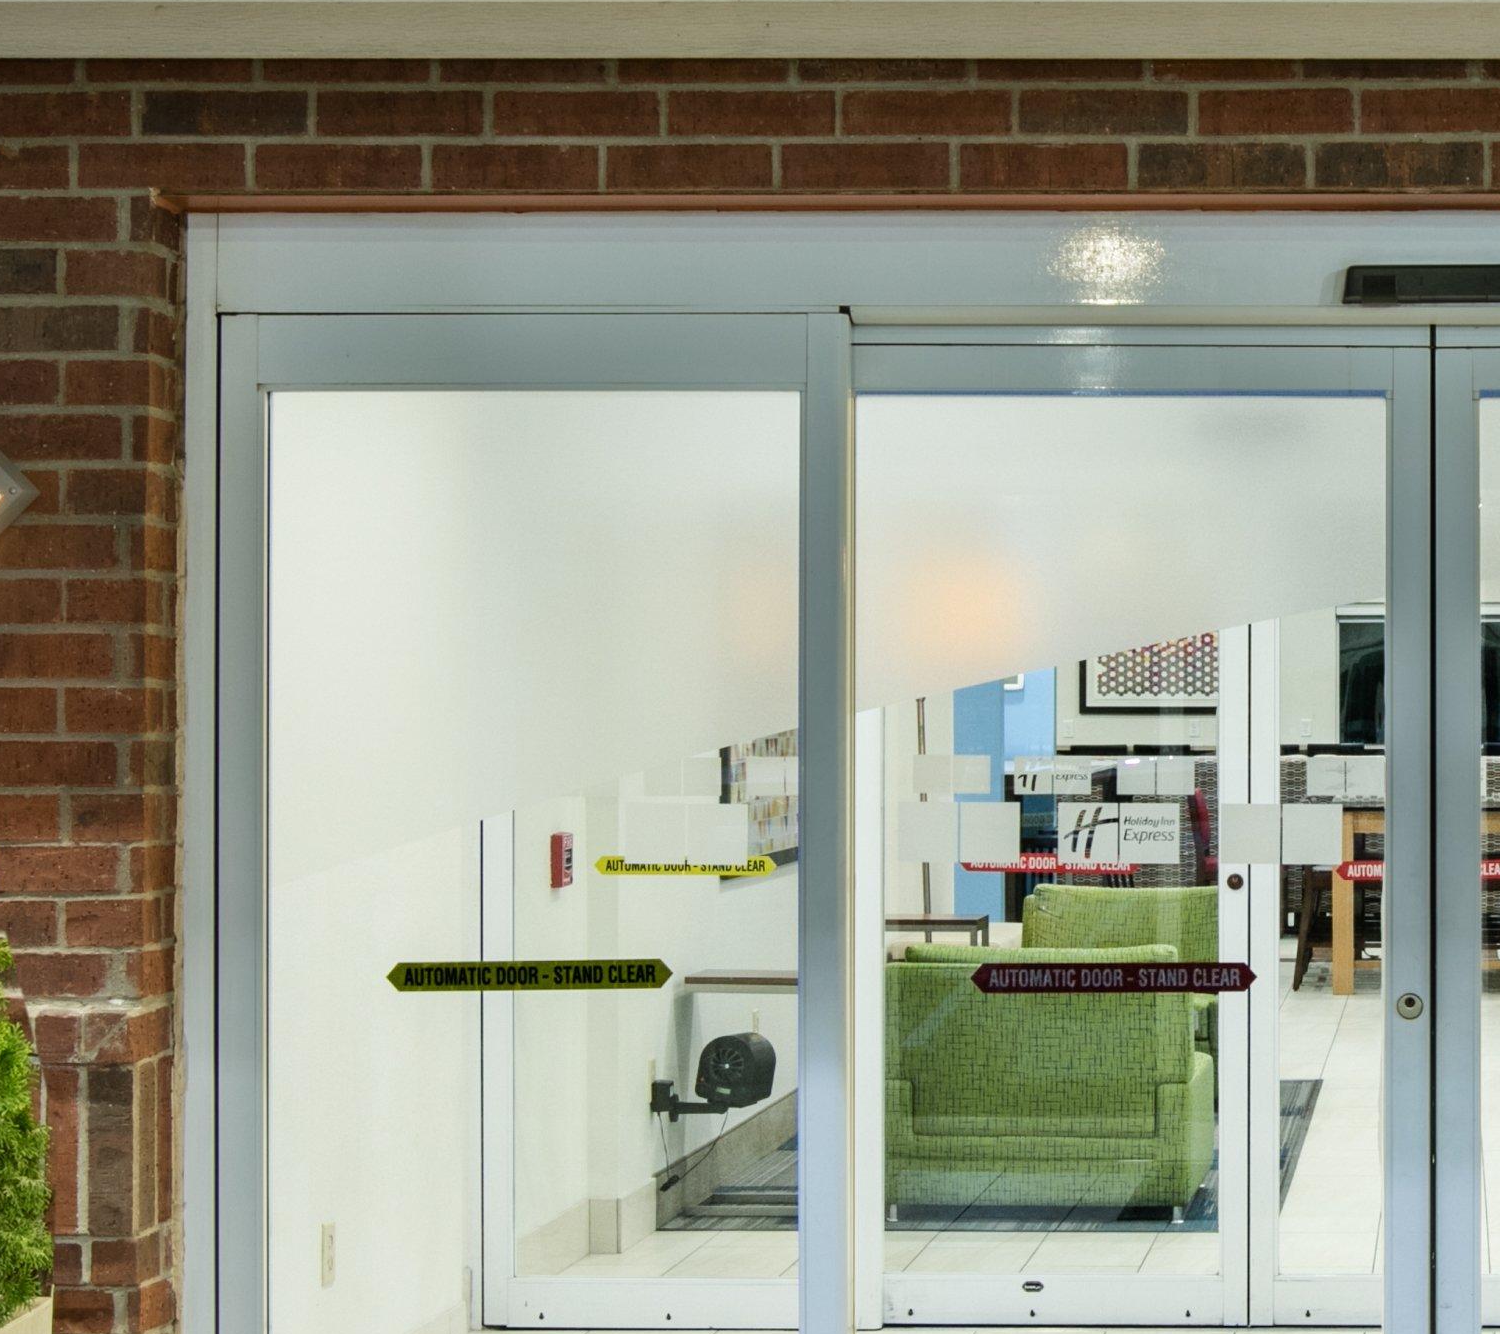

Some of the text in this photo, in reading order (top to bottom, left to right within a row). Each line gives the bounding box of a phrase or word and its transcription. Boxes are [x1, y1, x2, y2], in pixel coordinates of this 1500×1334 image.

[1124, 816, 1175, 827] Holiday Inn
[1124, 828, 1175, 844] Express
[1029, 856, 1056, 870] DOOR
[1347, 864, 1383, 878] AUTOM
[404, 967, 491, 986] AUTOMATIC
[496, 966, 538, 985] DOOR
[553, 965, 603, 985] STAND
[608, 964, 656, 984] CLEAR
[989, 969, 1075, 988] AUTOMATIC
[1081, 968, 1123, 987] DOOR
[1138, 968, 1187, 987] STAND
[1192, 968, 1240, 987] CLEAR
